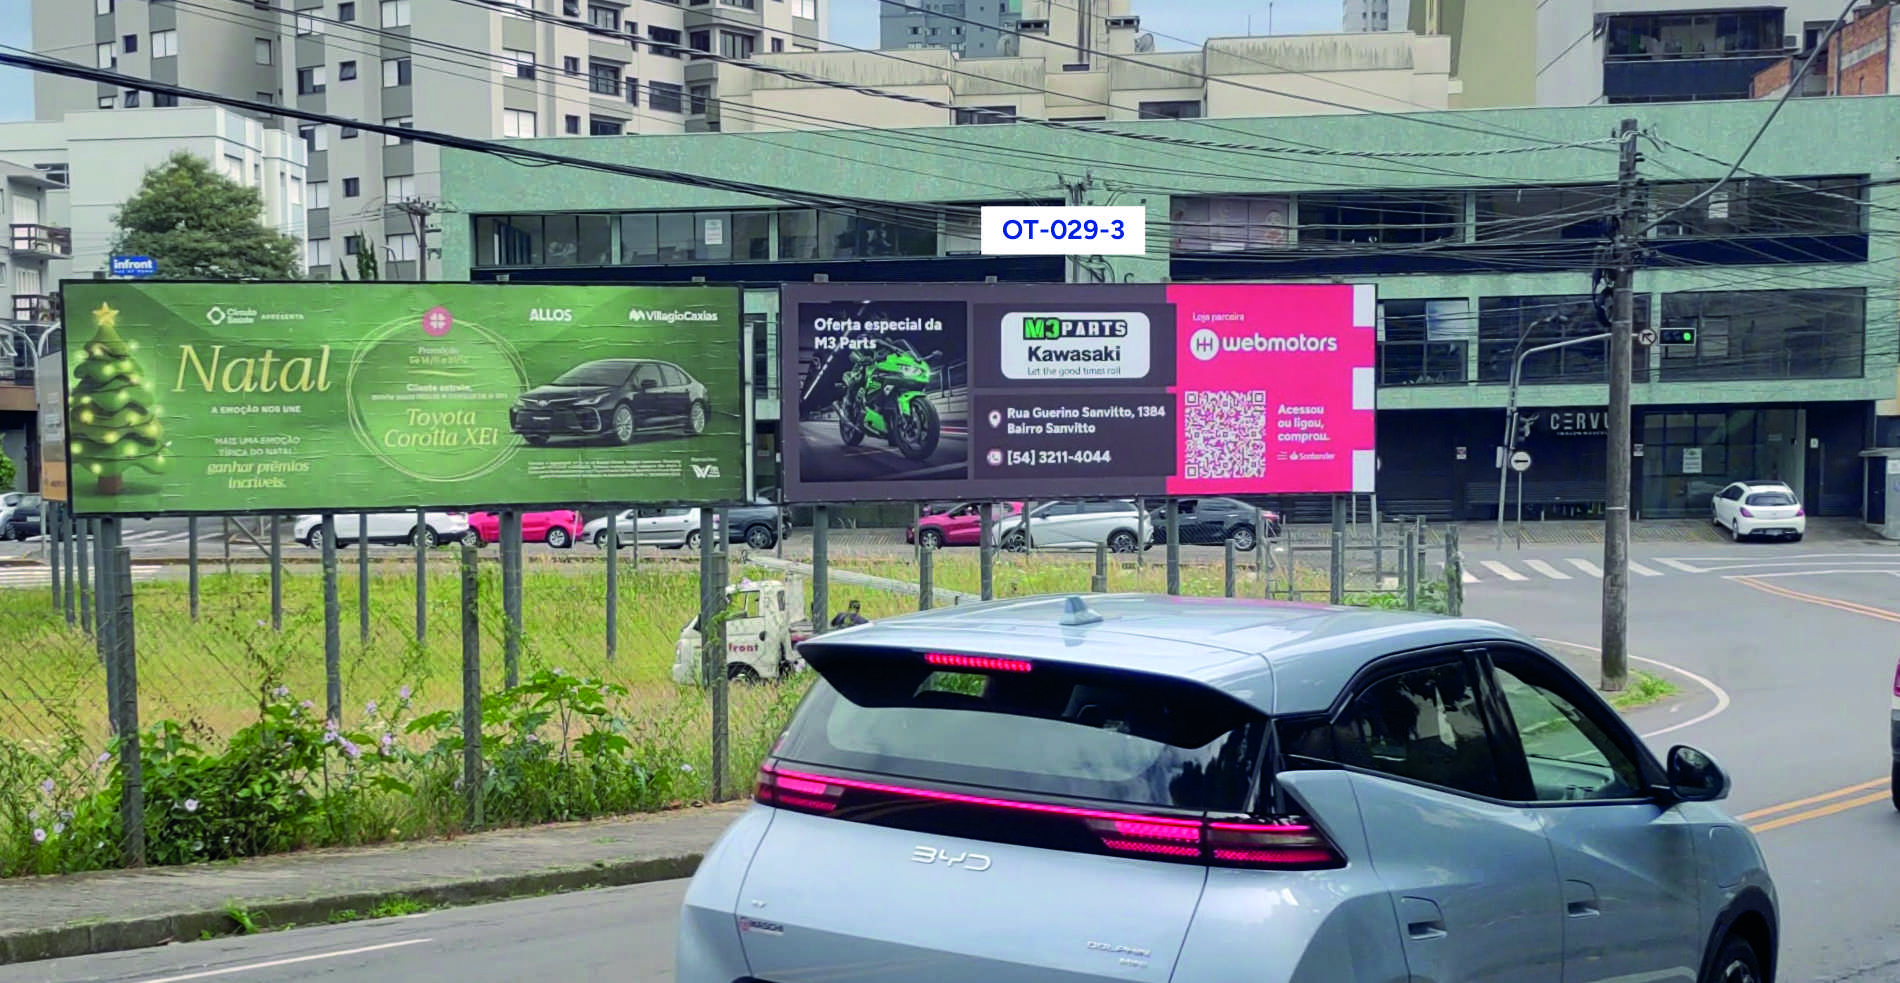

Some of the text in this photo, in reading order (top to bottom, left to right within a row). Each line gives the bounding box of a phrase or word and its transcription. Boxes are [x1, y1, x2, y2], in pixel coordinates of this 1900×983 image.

[113, 259, 153, 269] infront
[529, 308, 573, 322] ALLOS
[1192, 312, 1245, 323] Loja parceira
[814, 317, 943, 334] Oferta especial da
[1024, 317, 1127, 340] M3PARTS
[814, 336, 877, 350] M3 Parts
[1222, 332, 1338, 352] webmotors
[1028, 346, 1121, 362] Kawasaki
[171, 344, 331, 393] Natal
[1027, 368, 1041, 376] Let
[1043, 367, 1057, 376] the
[1059, 367, 1081, 377] good
[220, 405, 259, 415] EMOÇÃO
[282, 405, 302, 413] UNE
[1007, 406, 1166, 418] Rua Guerino Sanvitto, 1384
[1277, 404, 1324, 415] Acessou
[407, 408, 477, 430] Toyota
[1277, 417, 1325, 430] ou ligou,
[1007, 423, 1096, 434] Bairro Sanvitto
[384, 428, 459, 447] Corolla
[1277, 432, 1331, 443] comprou.
[1038, 450, 1112, 463] 3211-4044
[207, 460, 311, 475] ganhar prêmios
[911, 845, 993, 872] BYD
